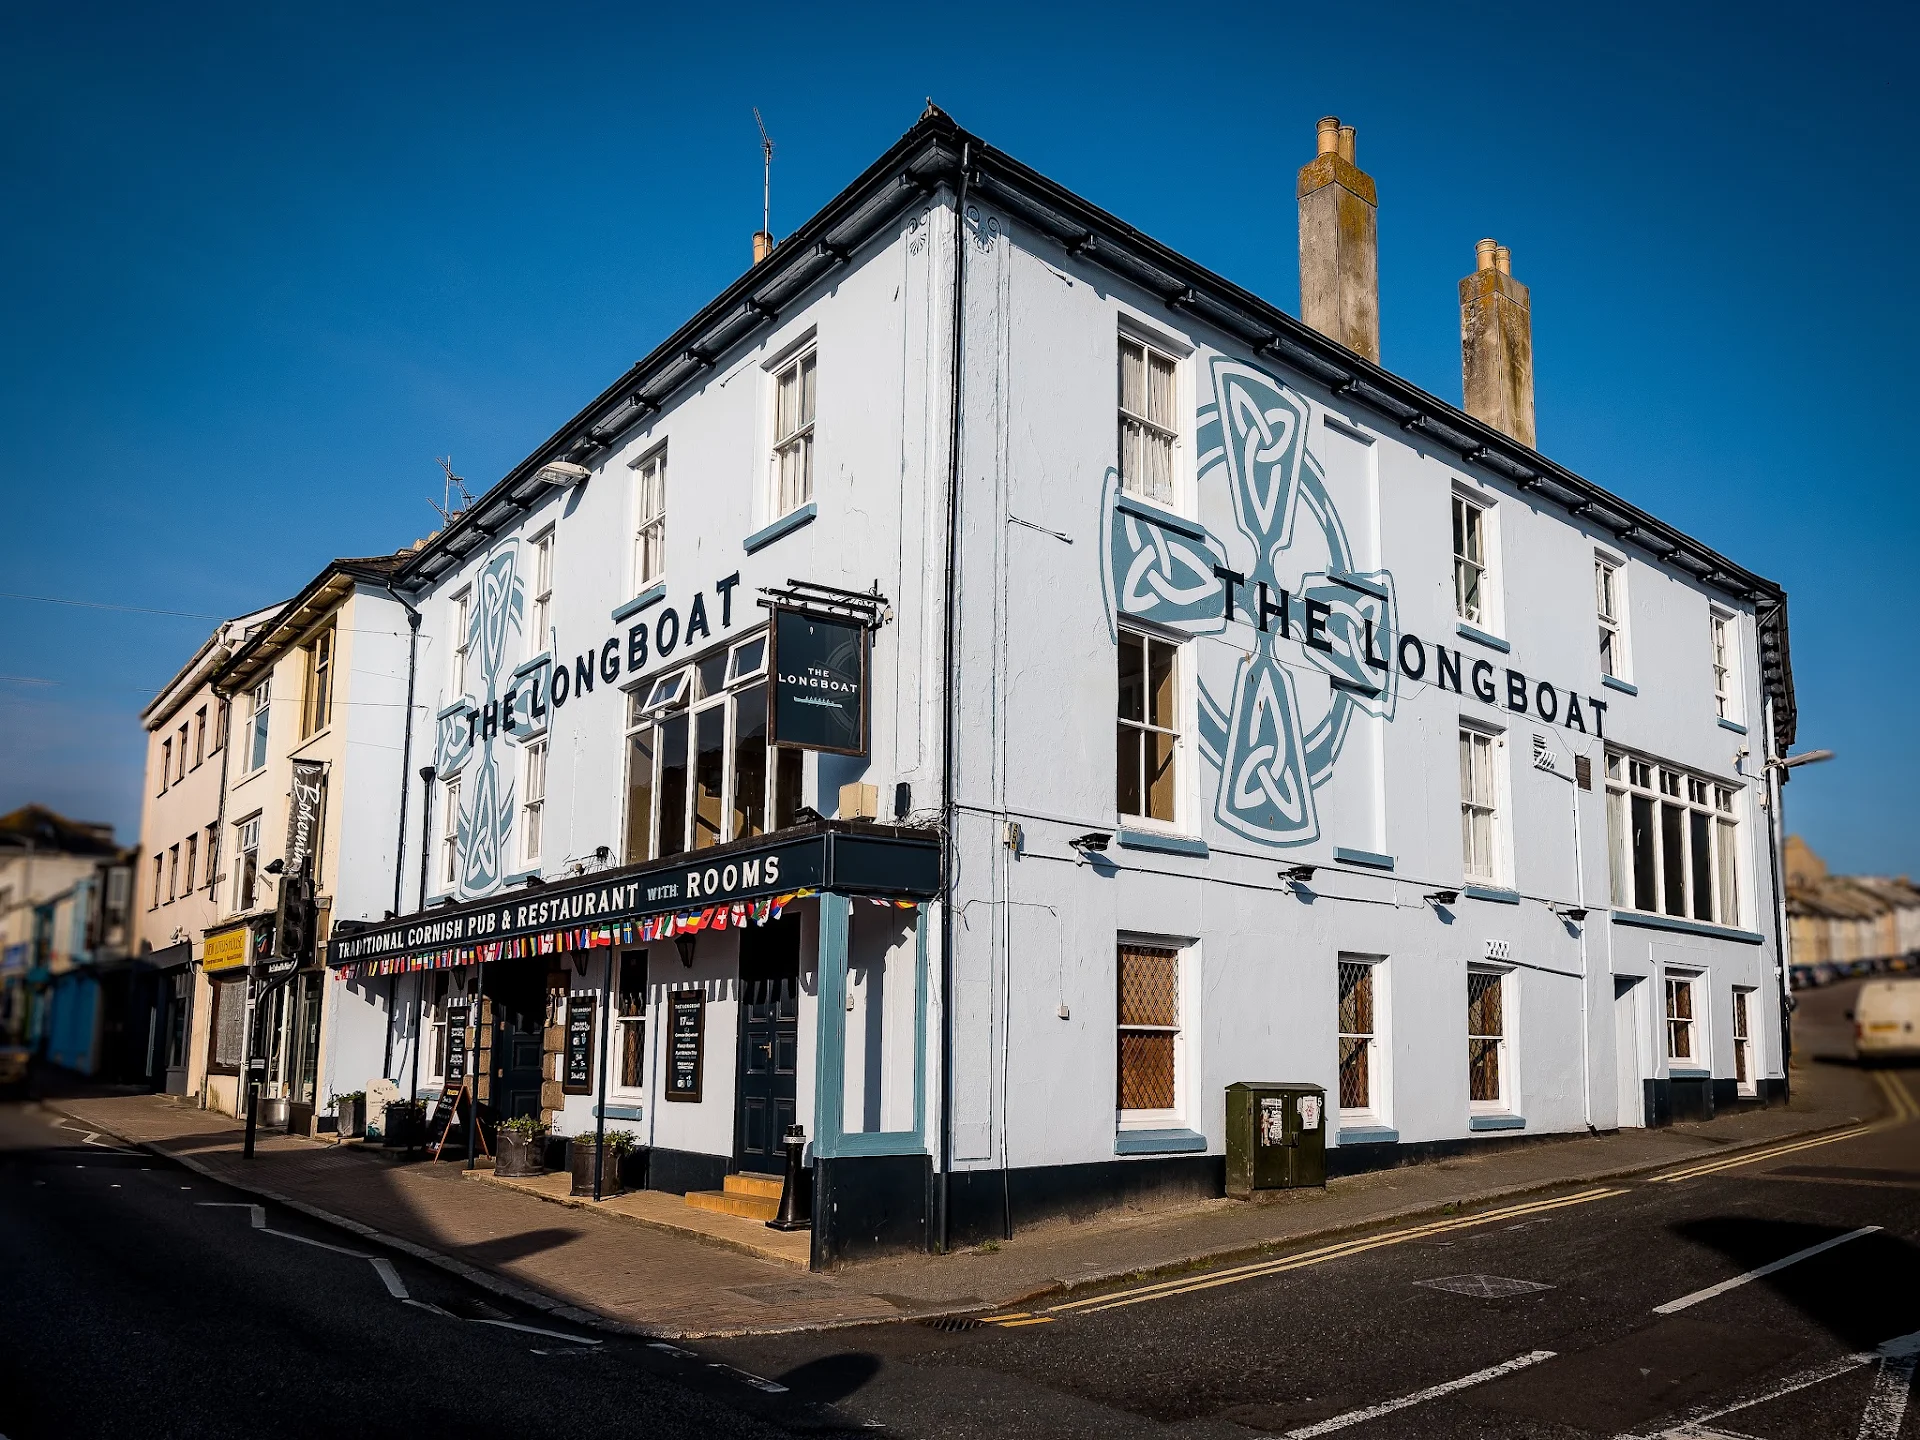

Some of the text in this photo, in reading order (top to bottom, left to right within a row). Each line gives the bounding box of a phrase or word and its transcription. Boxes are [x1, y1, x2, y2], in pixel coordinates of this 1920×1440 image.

[466, 570, 740, 747] THE LONGBOAT
[778, 672, 858, 693] LONGBOAT
[807, 667, 830, 678] THE
[1213, 563, 1608, 738] THE LONGBOAT
[338, 855, 780, 959] TRADITIONAL CORNISH PUB & RESTAURANT WITH ROOMS
